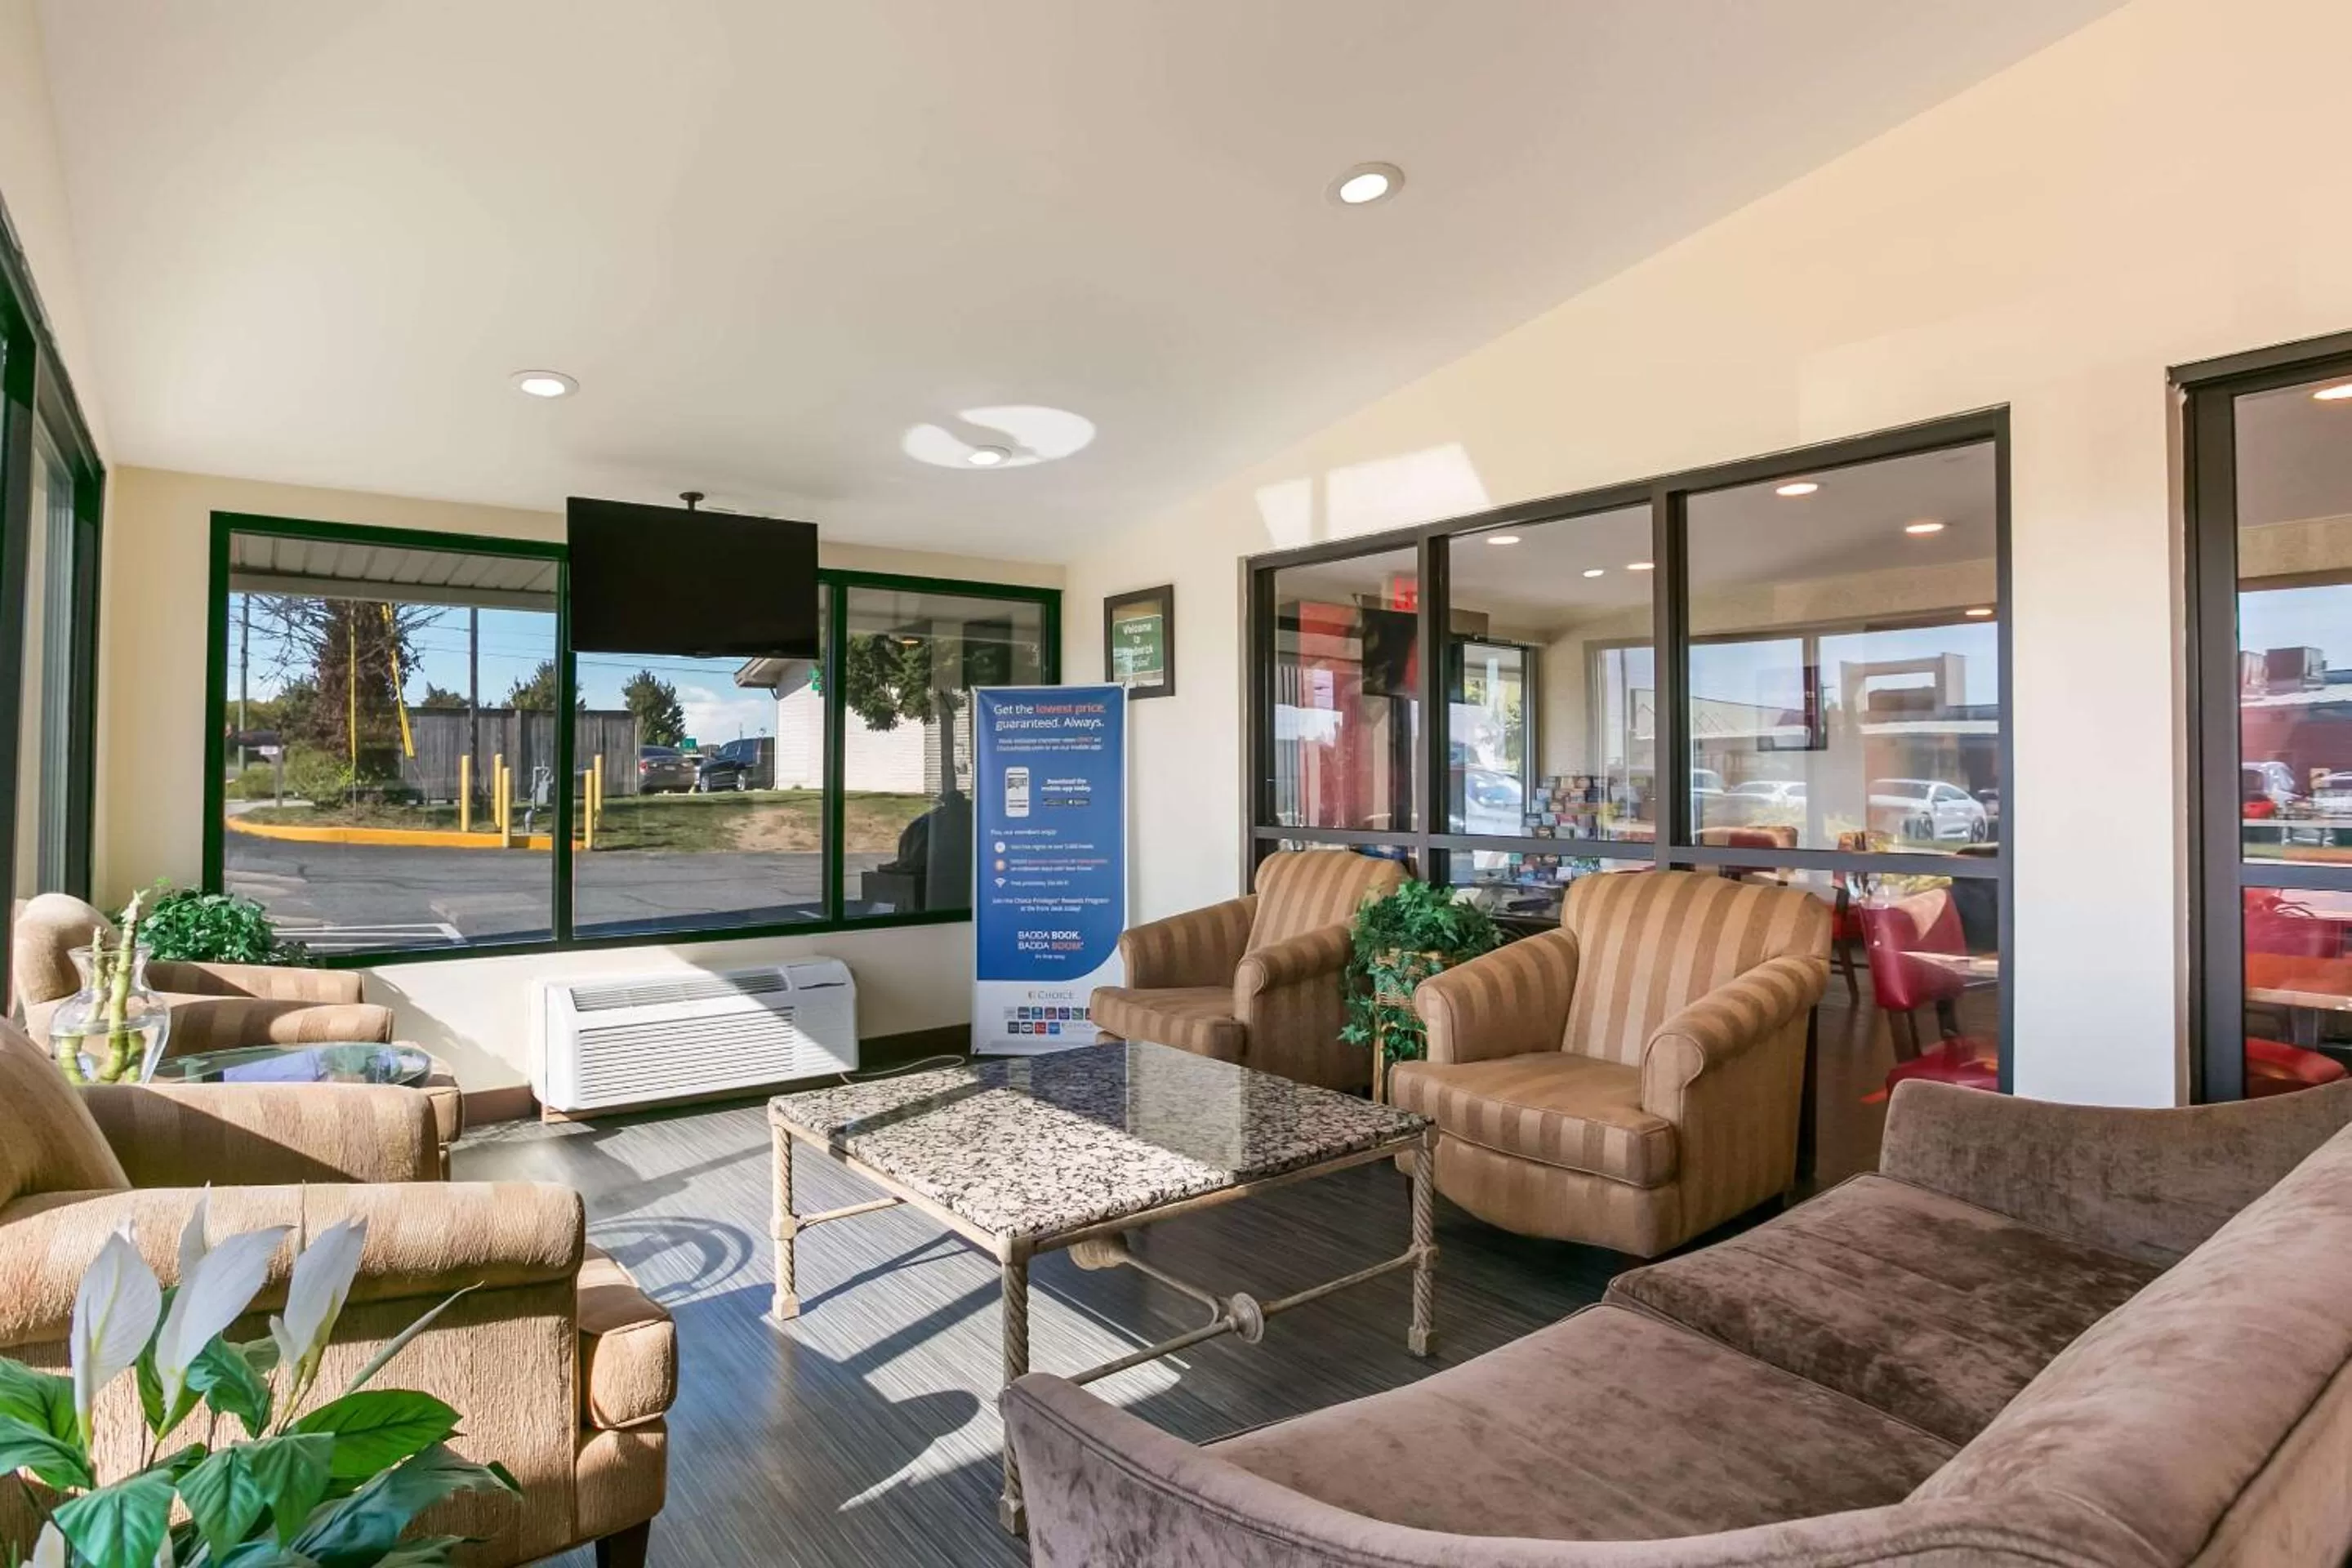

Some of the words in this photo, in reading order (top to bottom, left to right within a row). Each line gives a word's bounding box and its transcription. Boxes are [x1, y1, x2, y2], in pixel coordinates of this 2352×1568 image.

[993, 704, 1013, 715] Get
[1016, 704, 1034, 714] the
[995, 717, 1061, 731] guaranteed.
[1064, 717, 1104, 730] Always.
